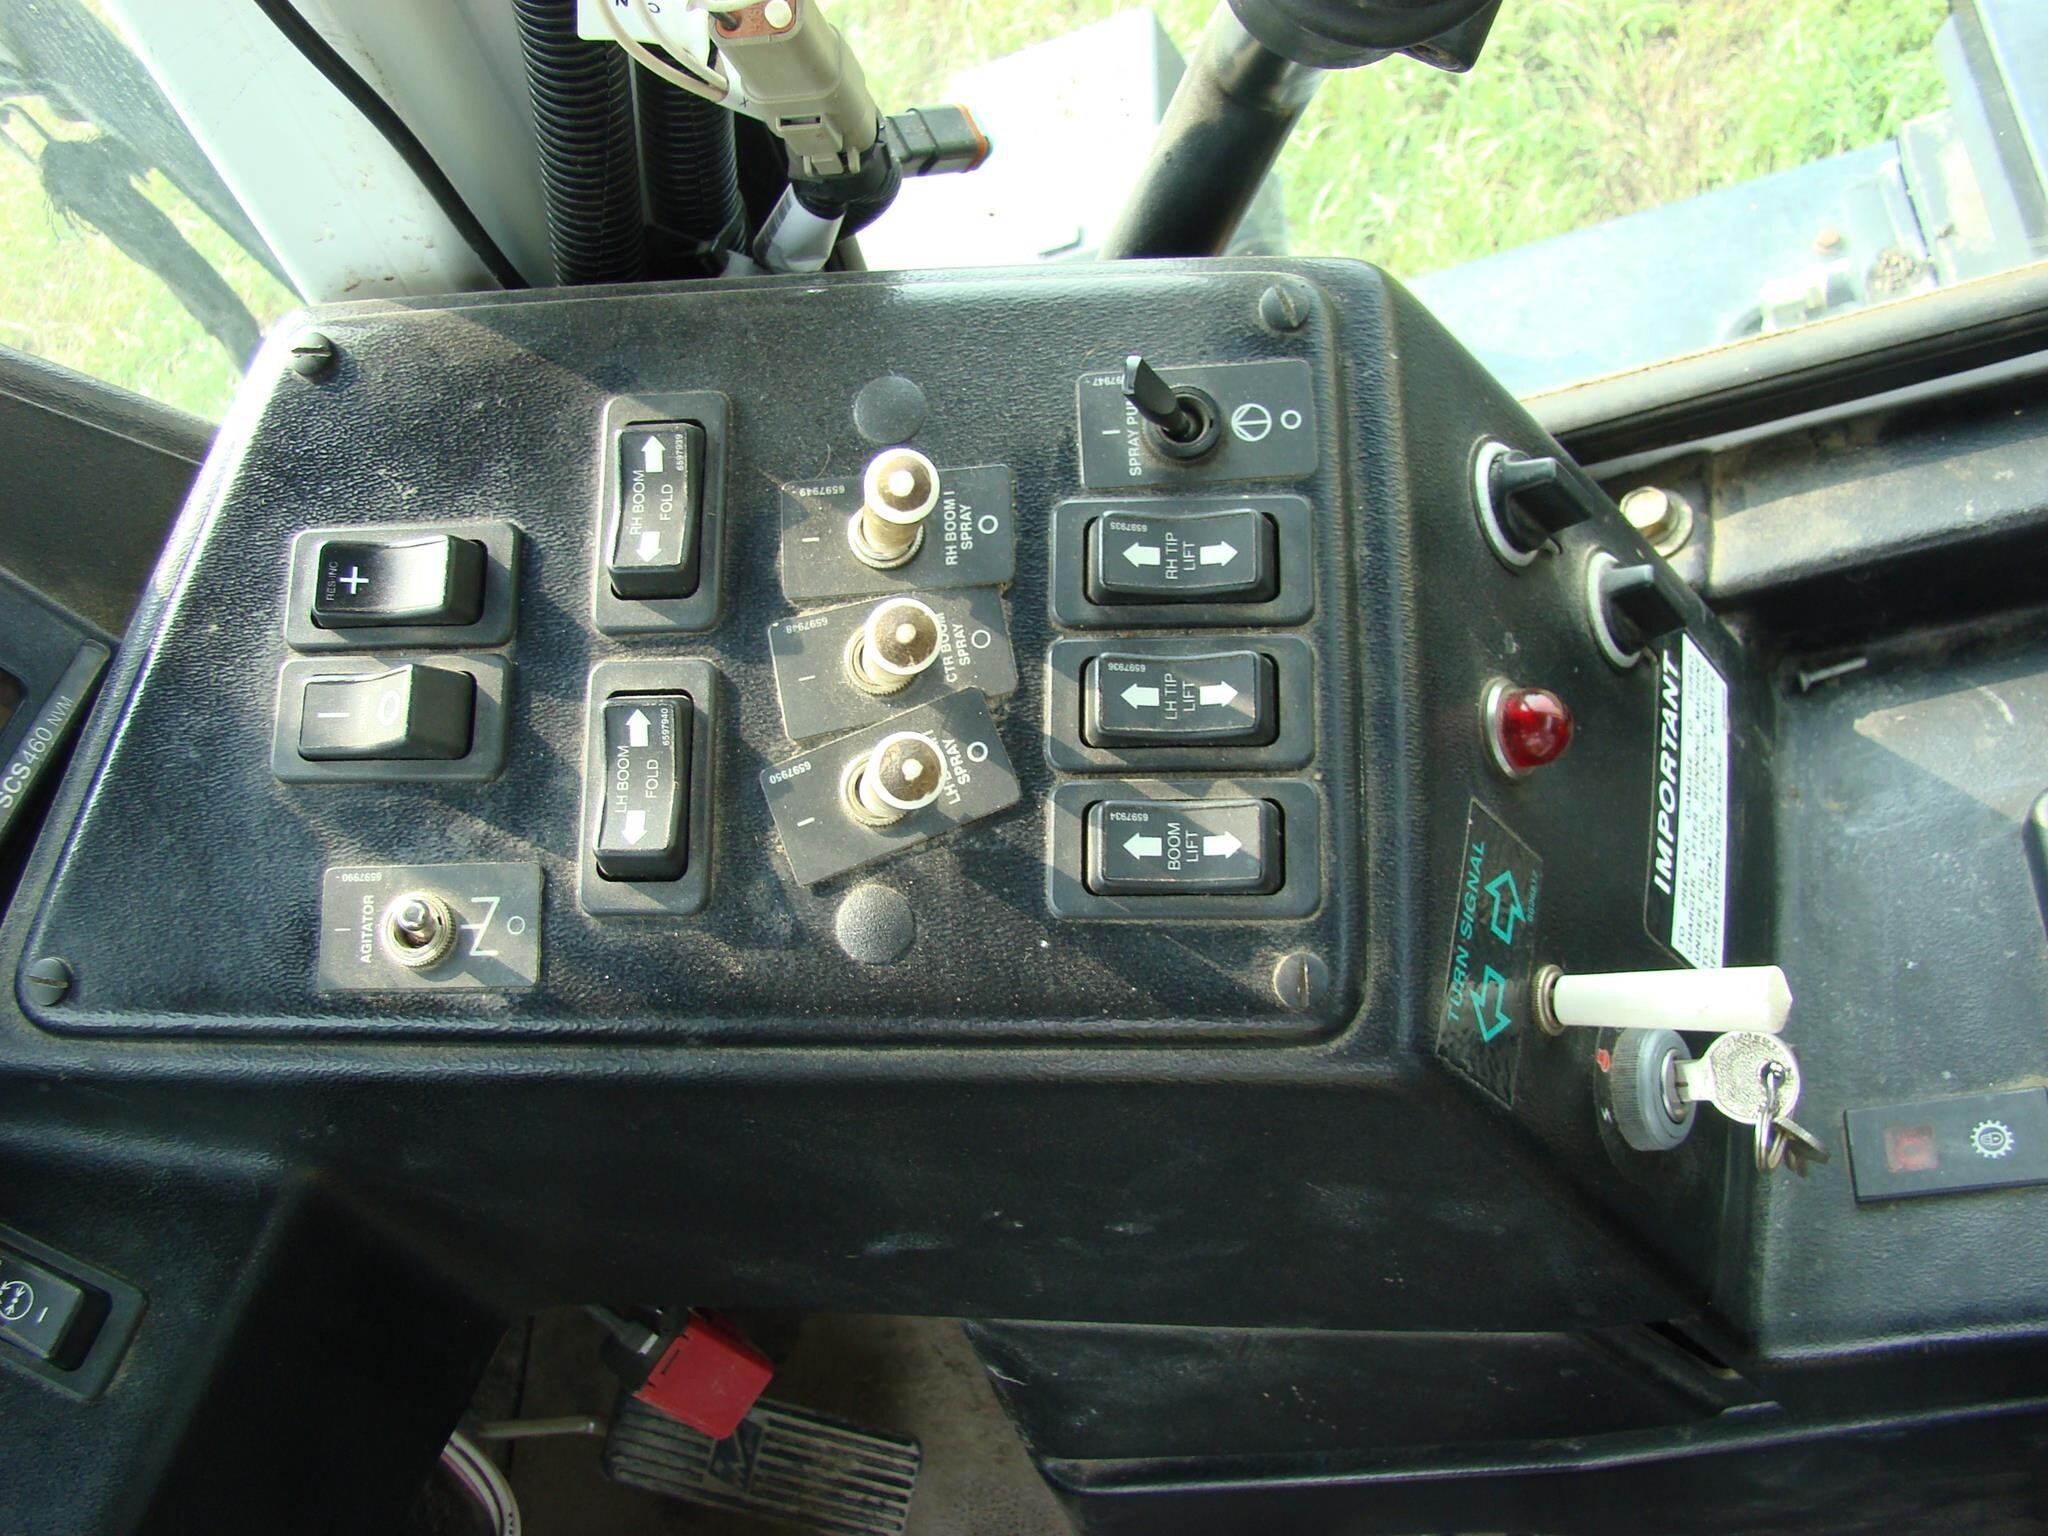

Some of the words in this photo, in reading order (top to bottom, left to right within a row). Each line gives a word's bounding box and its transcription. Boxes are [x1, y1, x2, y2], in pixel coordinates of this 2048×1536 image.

[1091, 375, 1123, 386] 97947
[1125, 400, 1138, 425] PU
[675, 433, 685, 471] 6597939
[1126, 429, 1142, 476] SPRAY
[632, 469, 646, 509] BOOM
[659, 483, 674, 521] FOLD
[629, 510, 642, 536] RH
[943, 498, 957, 542] BOOM
[959, 504, 973, 550] SPRAY
[944, 545, 958, 566] RH
[1165, 532, 1179, 556] TIP
[1182, 541, 1196, 571] LIFT
[1165, 558, 1178, 579] RH
[951, 623, 971, 666] SPRAY
[942, 656, 958, 683] CTR
[1164, 672, 1178, 696] TIP
[1164, 700, 1178, 720] LH
[1182, 681, 1196, 712] LIFT
[661, 707, 670, 746] 6597940
[0, 762, 32, 808] SCS
[23, 727, 53, 764] 460
[47, 695, 74, 727] NVM
[616, 745, 631, 790] BOOM
[941, 738, 971, 785] SPRAY
[645, 759, 659, 799] FOLD
[768, 760, 812, 785] 6597950
[1654, 649, 1681, 895] IMPORTANT
[1685, 756, 1693, 820] DAMAGE
[614, 790, 629, 813] LH
[942, 781, 961, 805] LH
[1110, 811, 1149, 822] 6597934
[1167, 822, 1181, 870] BOOM
[1185, 830, 1199, 863] LIFT
[1681, 834, 1690, 909] PREVENT
[359, 894, 375, 964] AGITATOR
[1448, 945, 1470, 1022] TURN
[1459, 841, 1486, 940] SIGNAL
[1694, 907, 1703, 961] UNDER
